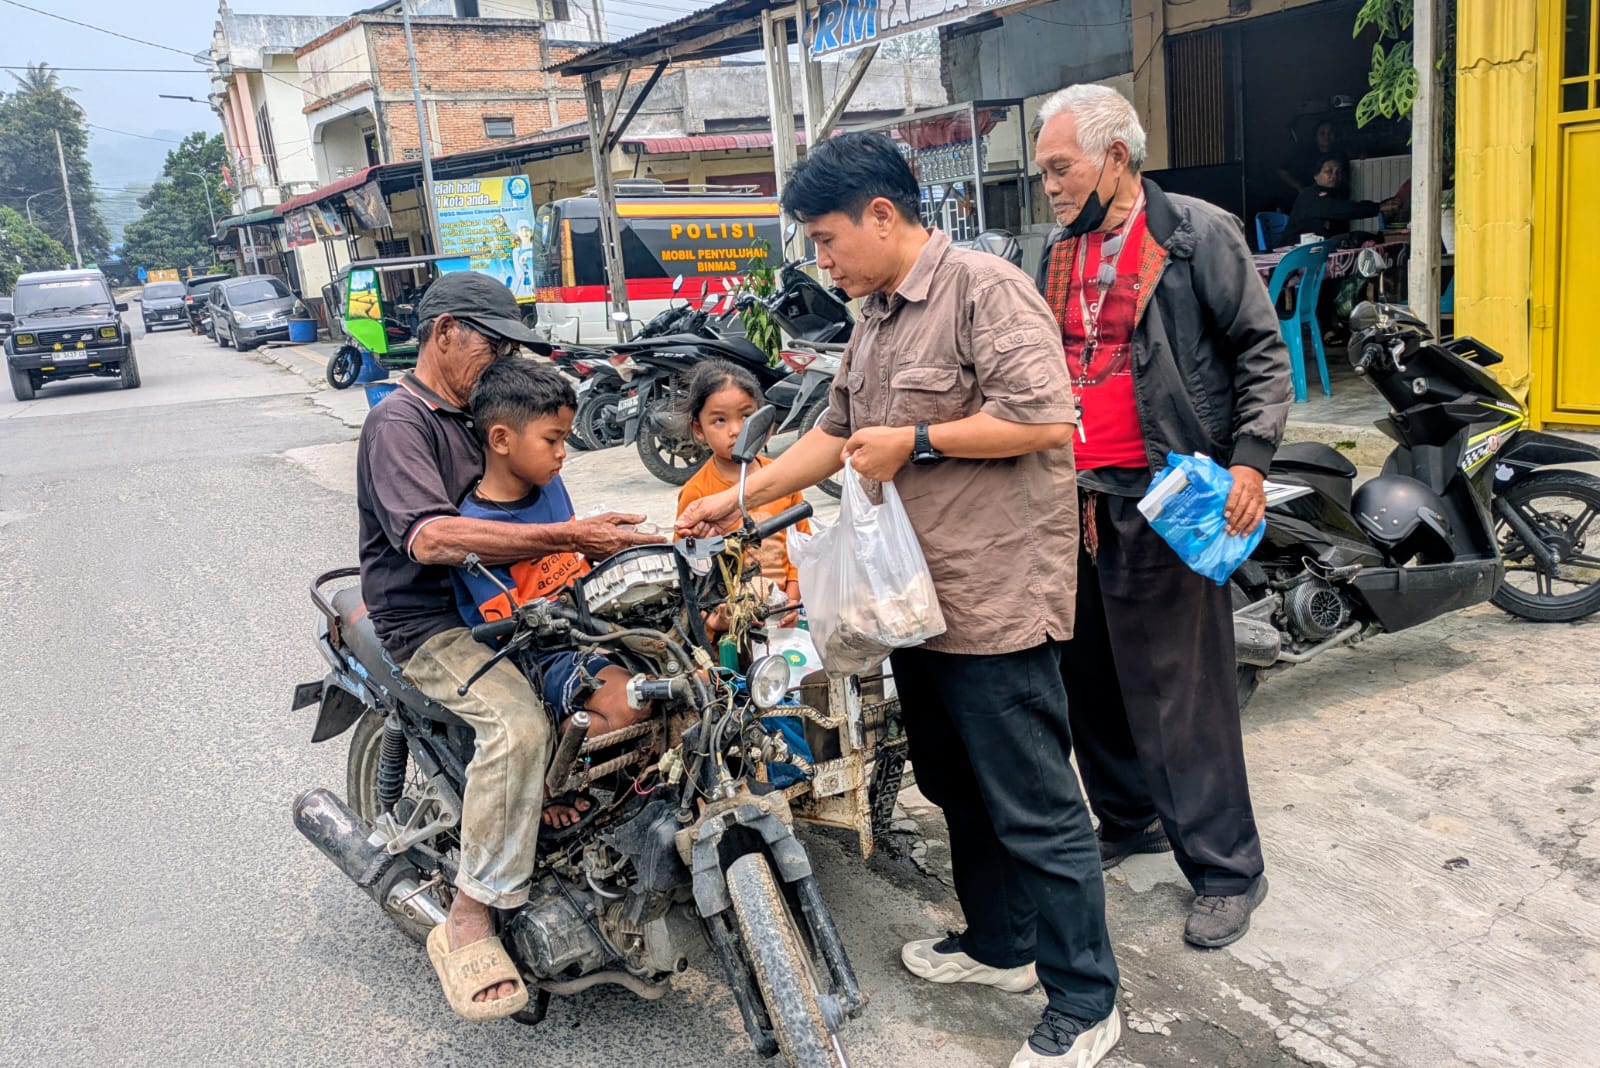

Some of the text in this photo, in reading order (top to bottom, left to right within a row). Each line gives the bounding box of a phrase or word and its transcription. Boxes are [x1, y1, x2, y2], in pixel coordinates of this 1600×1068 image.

[434, 184, 454, 195] elah
[443, 196, 464, 208] kota
[670, 222, 755, 240] POLISI
[661, 250, 696, 261] MOBIL
[697, 261, 737, 272] BINMAS
